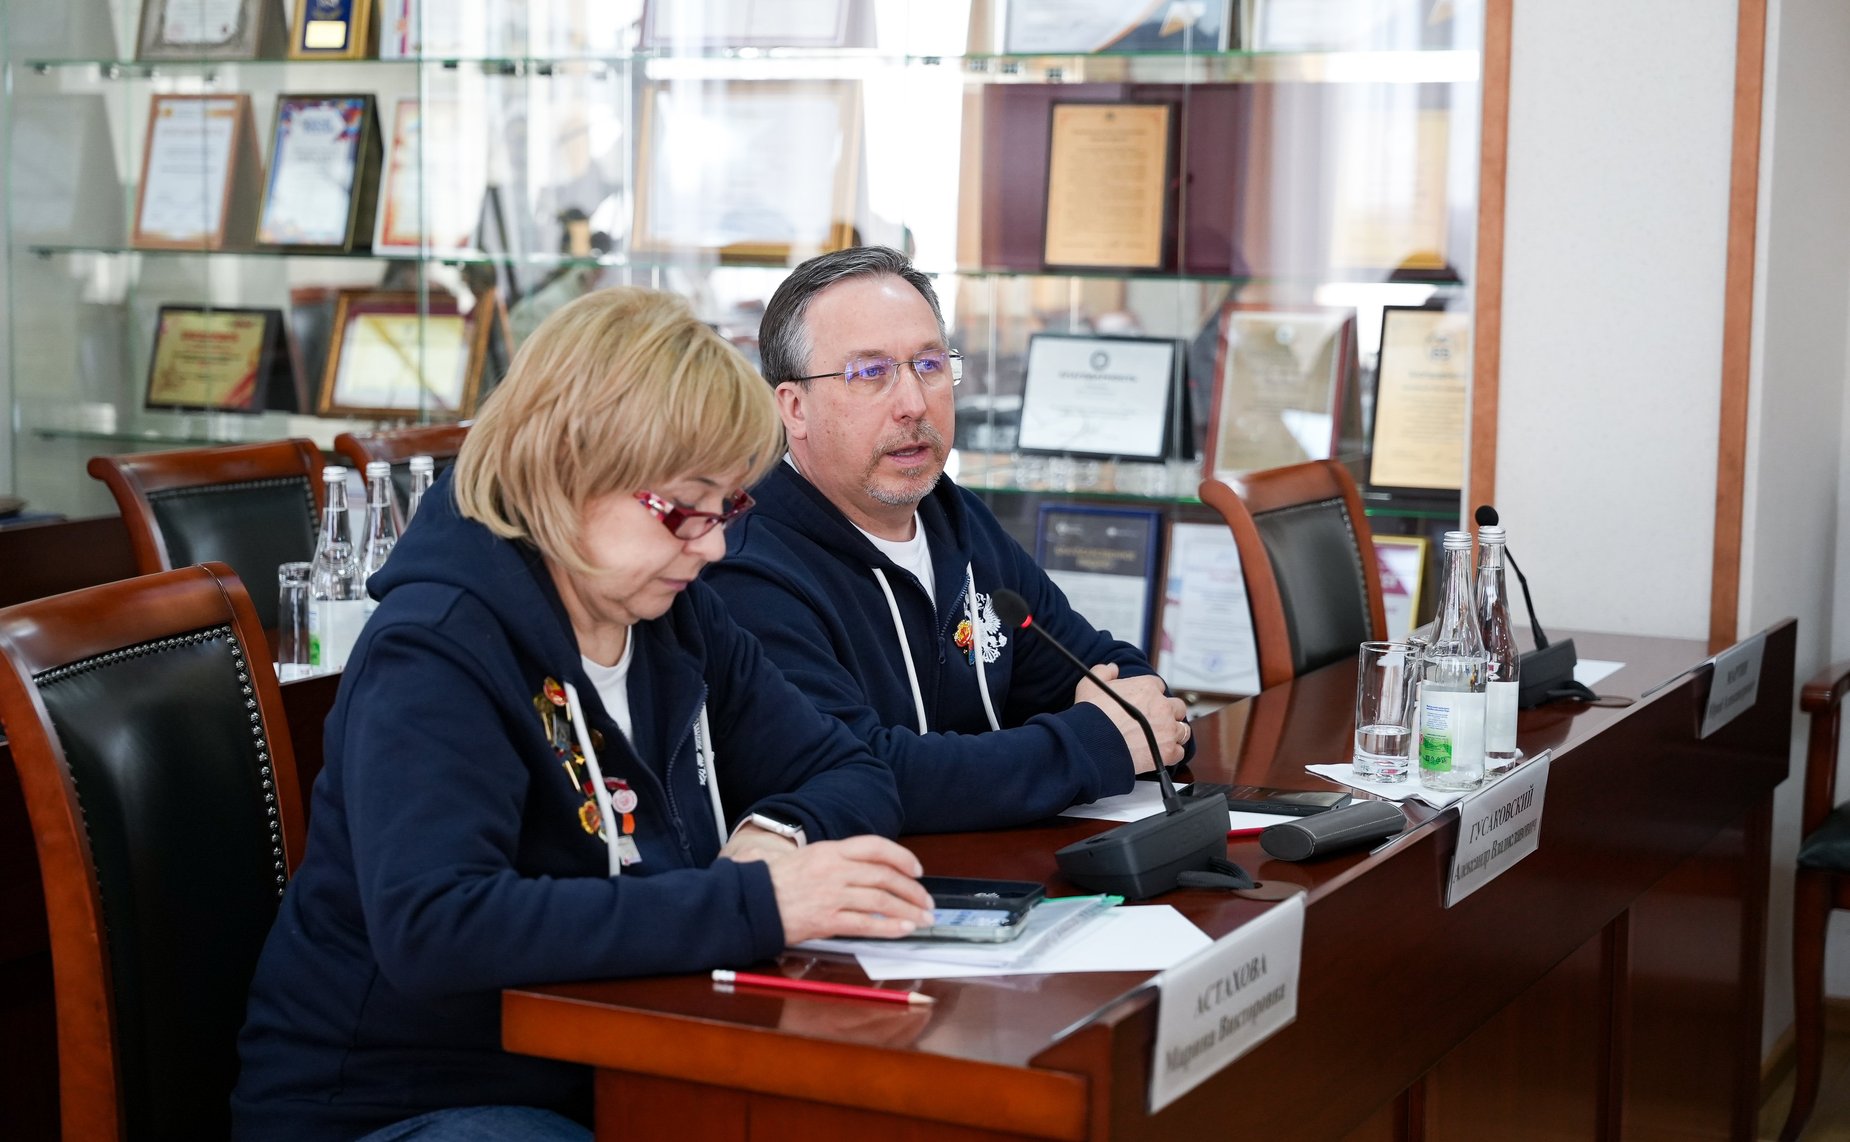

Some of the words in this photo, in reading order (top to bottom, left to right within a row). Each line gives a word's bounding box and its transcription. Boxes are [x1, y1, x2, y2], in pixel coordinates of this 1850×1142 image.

[1469, 784, 1535, 844] ГУСАКОВСКИЙ
[1453, 848, 1491, 884] Александр
[1194, 952, 1268, 1016] АСТАХОВА
[1166, 1029, 1217, 1074] Марина
[1218, 983, 1286, 1039] Викторовна
